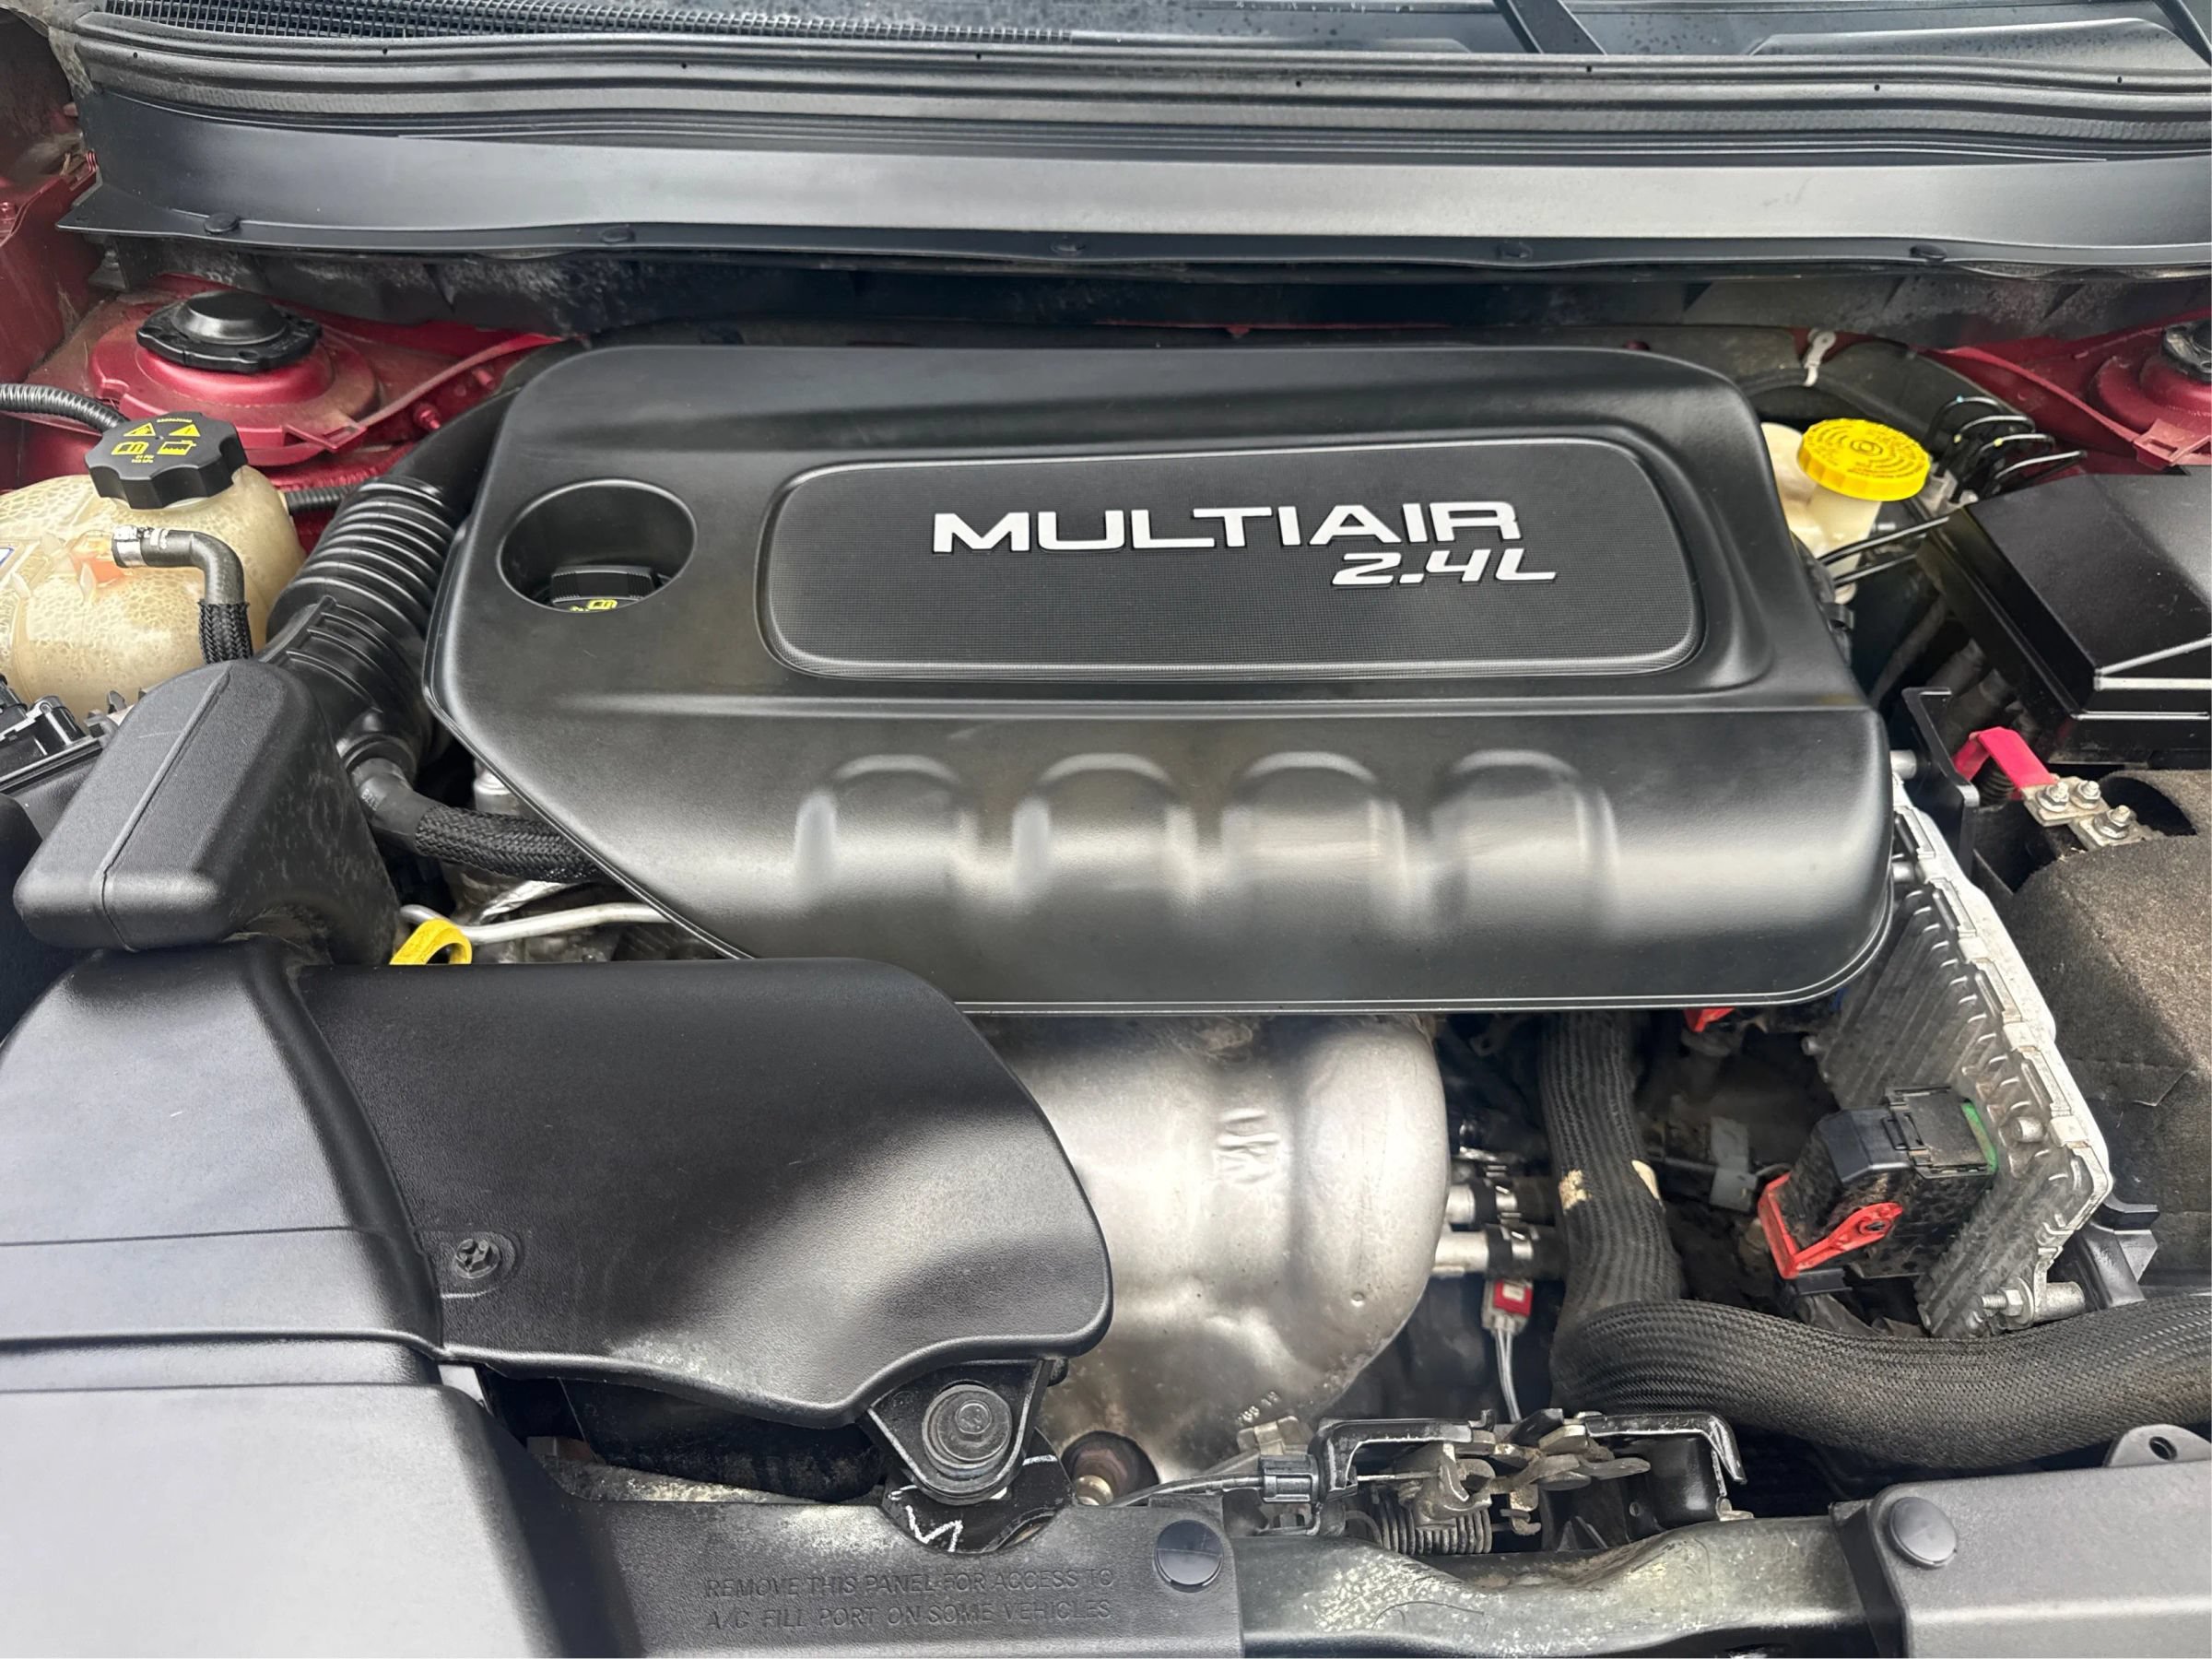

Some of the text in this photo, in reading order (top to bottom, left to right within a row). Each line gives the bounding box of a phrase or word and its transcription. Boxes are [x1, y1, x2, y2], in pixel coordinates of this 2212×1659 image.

[932, 500, 1522, 553] MULTIAIR
[1331, 547, 1558, 586] 2.4L
[706, 1568, 1114, 1597] REMOVE THIS PANEL FOR ACCESS TO
[707, 1599, 1112, 1630] A/C FILL PORT ON SOME VEHICLES
